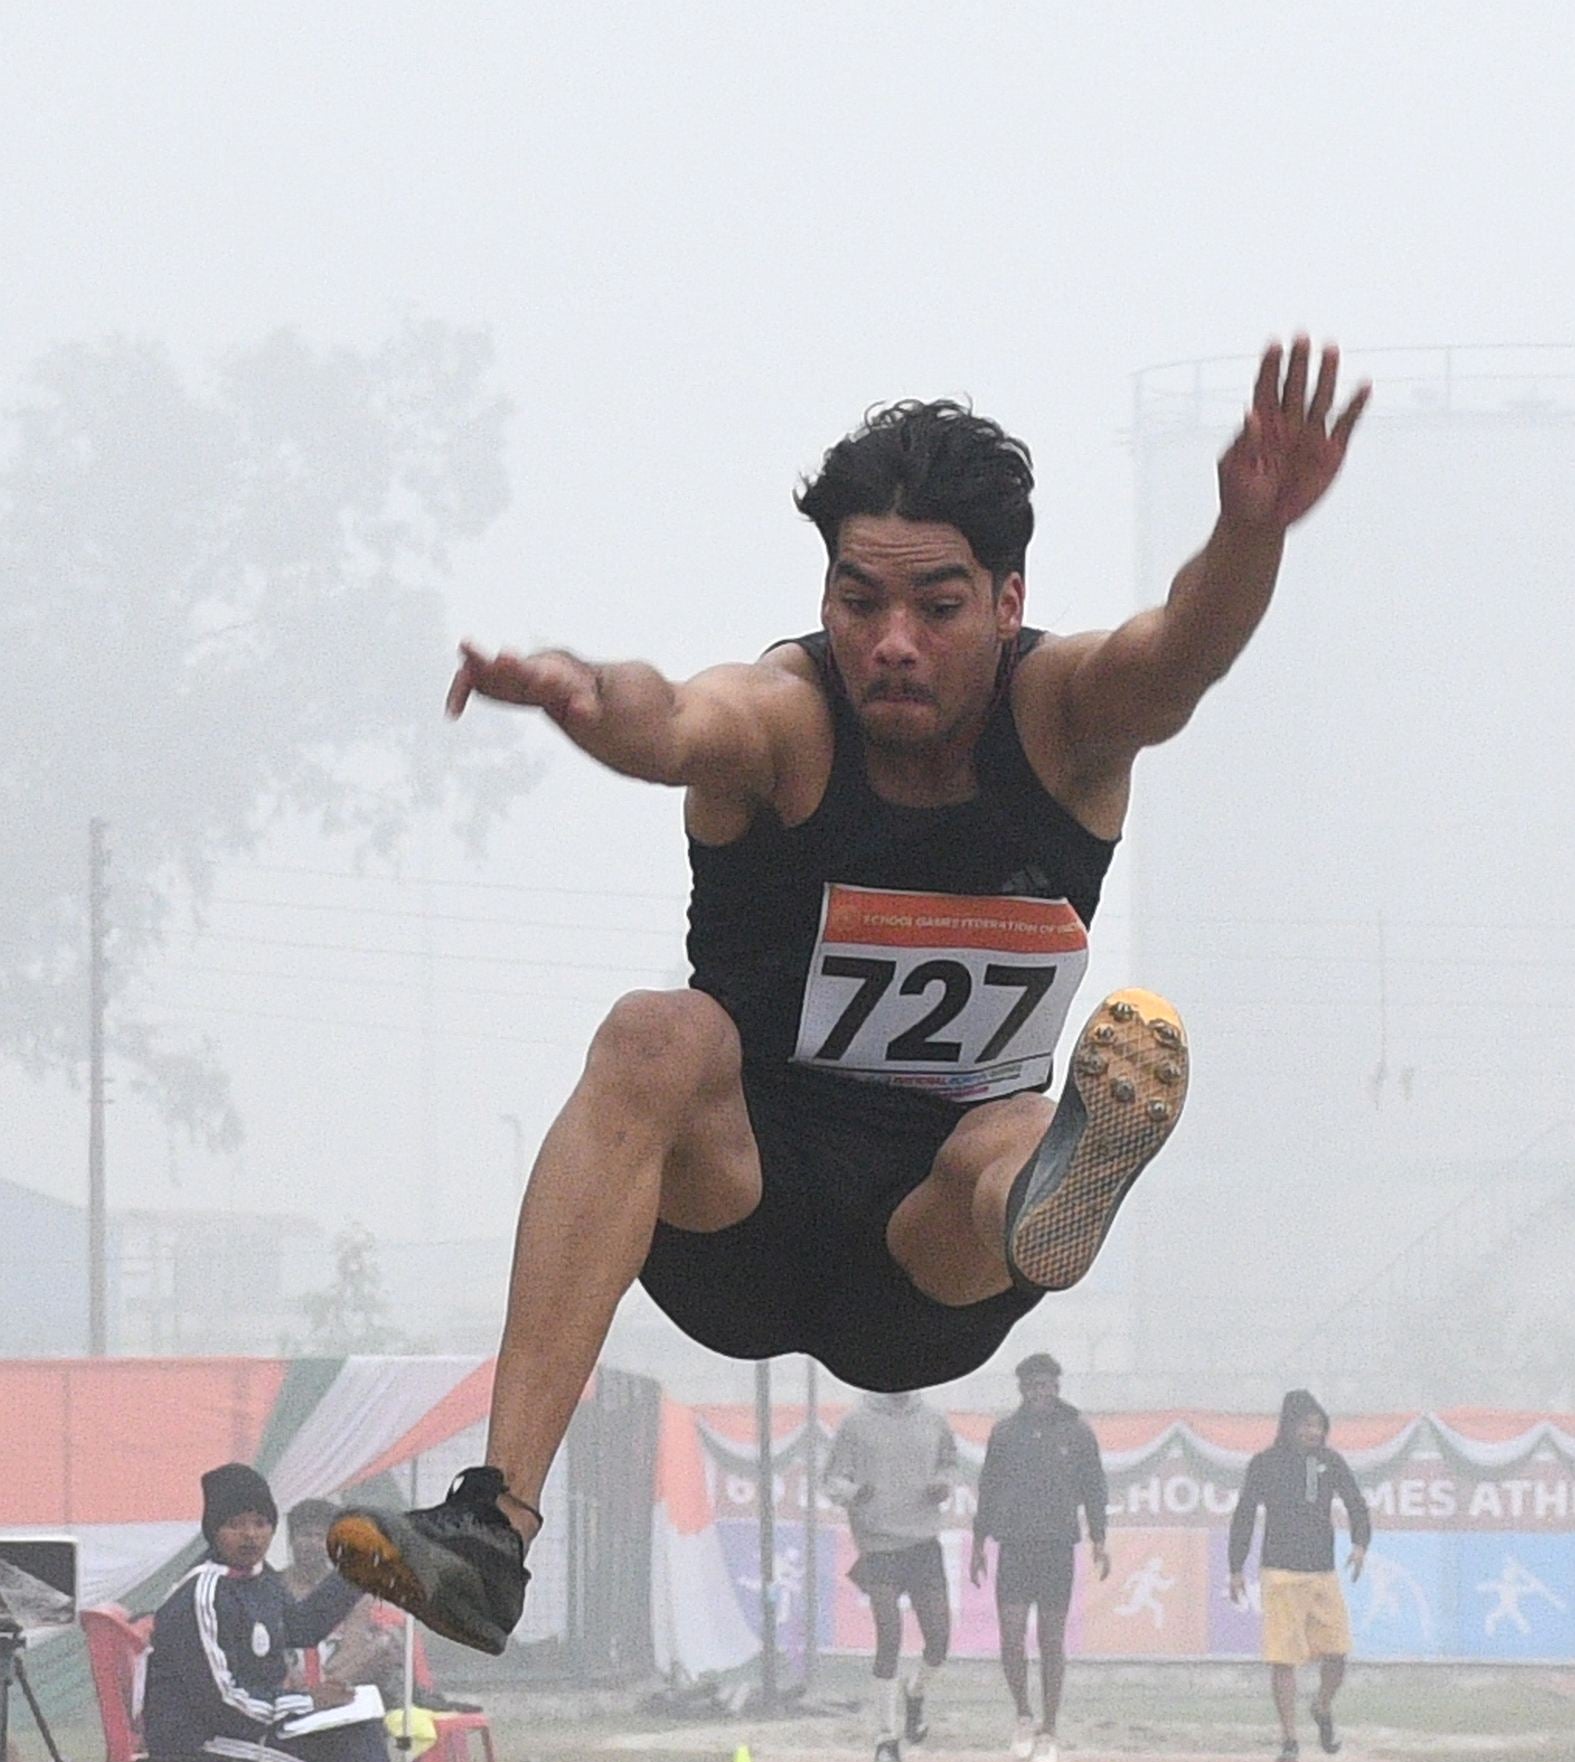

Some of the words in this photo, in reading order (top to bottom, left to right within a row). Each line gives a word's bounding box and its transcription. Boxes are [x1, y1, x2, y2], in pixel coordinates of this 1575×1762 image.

[863, 914, 913, 927] SCHOOL
[961, 918, 1038, 933] FEDERATION
[811, 955, 1057, 1064] 727
[1468, 1479, 1575, 1518] ATH
